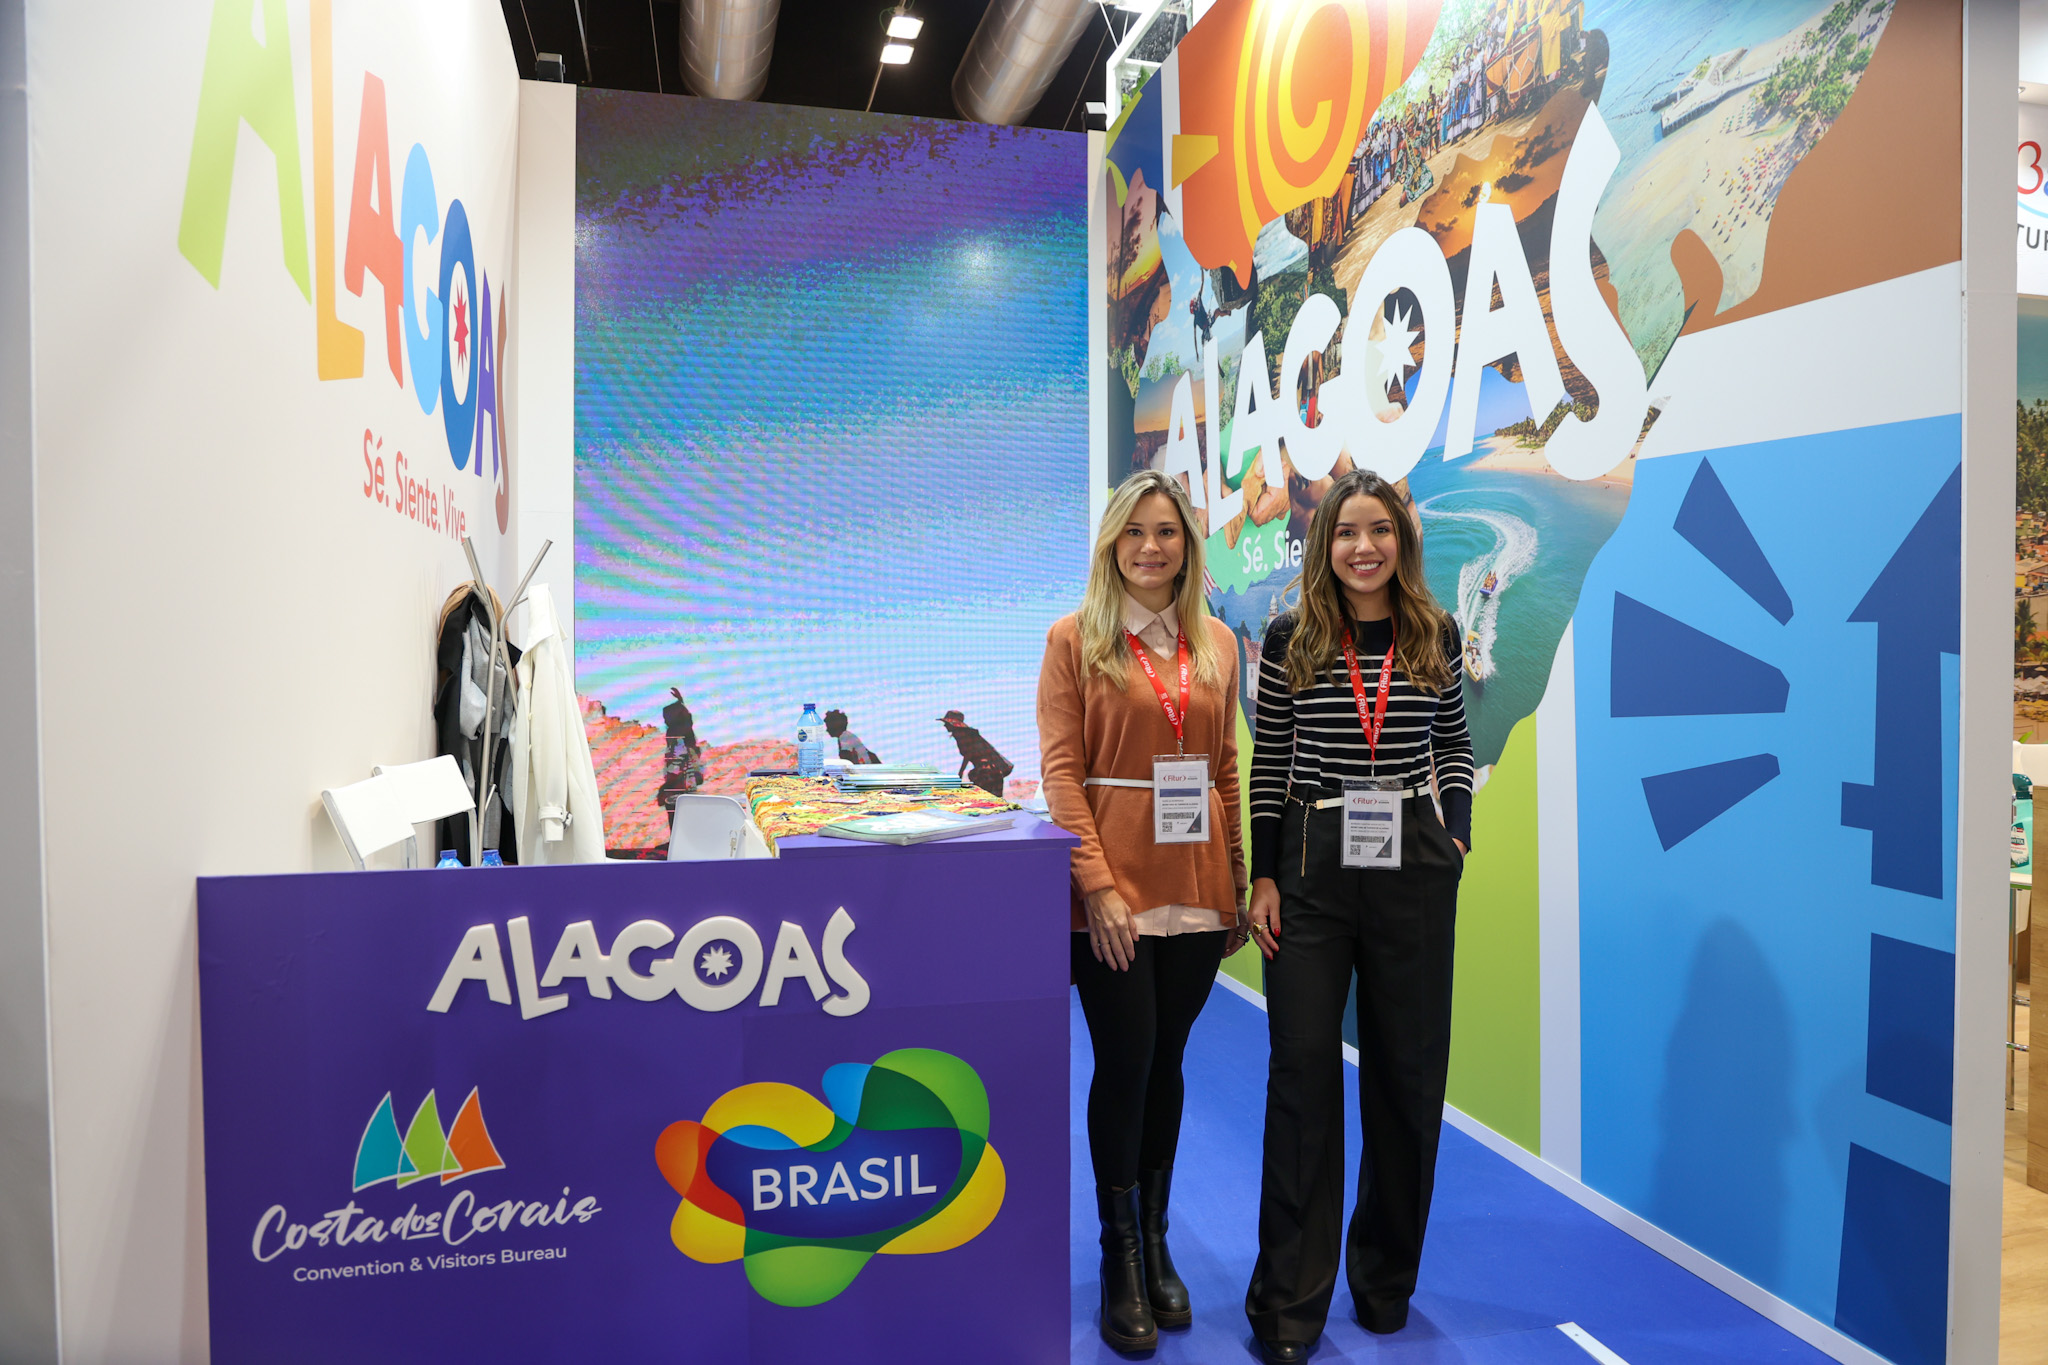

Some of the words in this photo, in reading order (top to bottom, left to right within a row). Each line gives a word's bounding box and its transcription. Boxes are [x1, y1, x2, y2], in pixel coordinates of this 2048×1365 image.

[178, 0, 507, 535] ALAGOAS
[1164, 100, 1648, 538] ALAGOAS
[363, 428, 389, 508] Sé.
[395, 450, 441, 534] Siente.
[1242, 533, 1268, 574] Sé.
[426, 906, 871, 1021] ALAGOAS
[252, 1200, 389, 1262] Costa
[390, 1203, 442, 1240] dos
[442, 1186, 602, 1246] Corais
[752, 1154, 937, 1211] BRASIL
[293, 1259, 405, 1282] Convention
[409, 1257, 423, 1271] &
[426, 1252, 496, 1270] Visitors
[500, 1246, 567, 1264] Bureau
